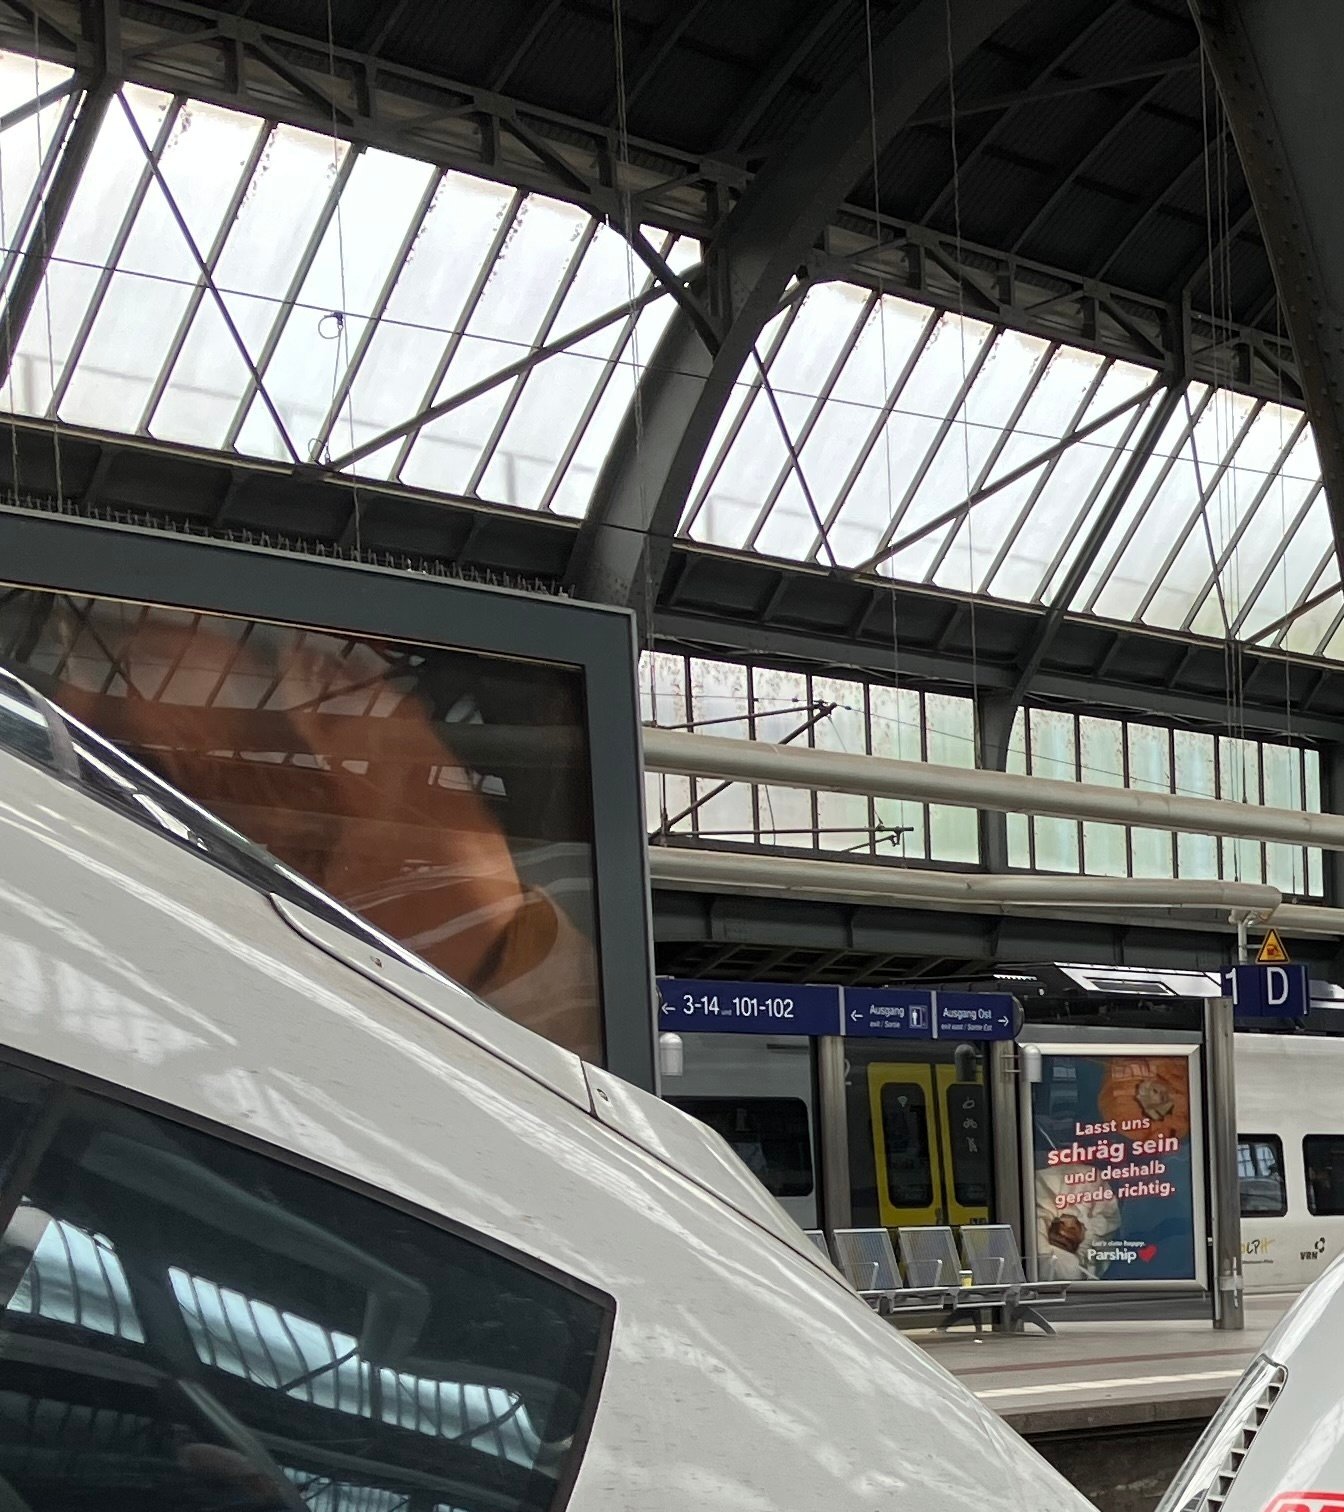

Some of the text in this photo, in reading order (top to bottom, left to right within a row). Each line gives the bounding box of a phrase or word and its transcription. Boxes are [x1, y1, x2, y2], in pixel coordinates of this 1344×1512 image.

[1225, 966, 1289, 1006] 1 D
[683, 994, 794, 1018] 3-14 101-102
[870, 1004, 905, 1018] Ausgang
[942, 1007, 992, 1021] Ausgang Ost
[1075, 1117, 1151, 1136] Lasst uns
[1047, 1132, 1179, 1165] schräg sein
[1064, 1159, 1166, 1184] und deshalb
[1055, 1179, 1176, 1209] gerade richtig.
[1087, 1247, 1137, 1264] Parship
[1300, 1251, 1318, 1260] VRN
